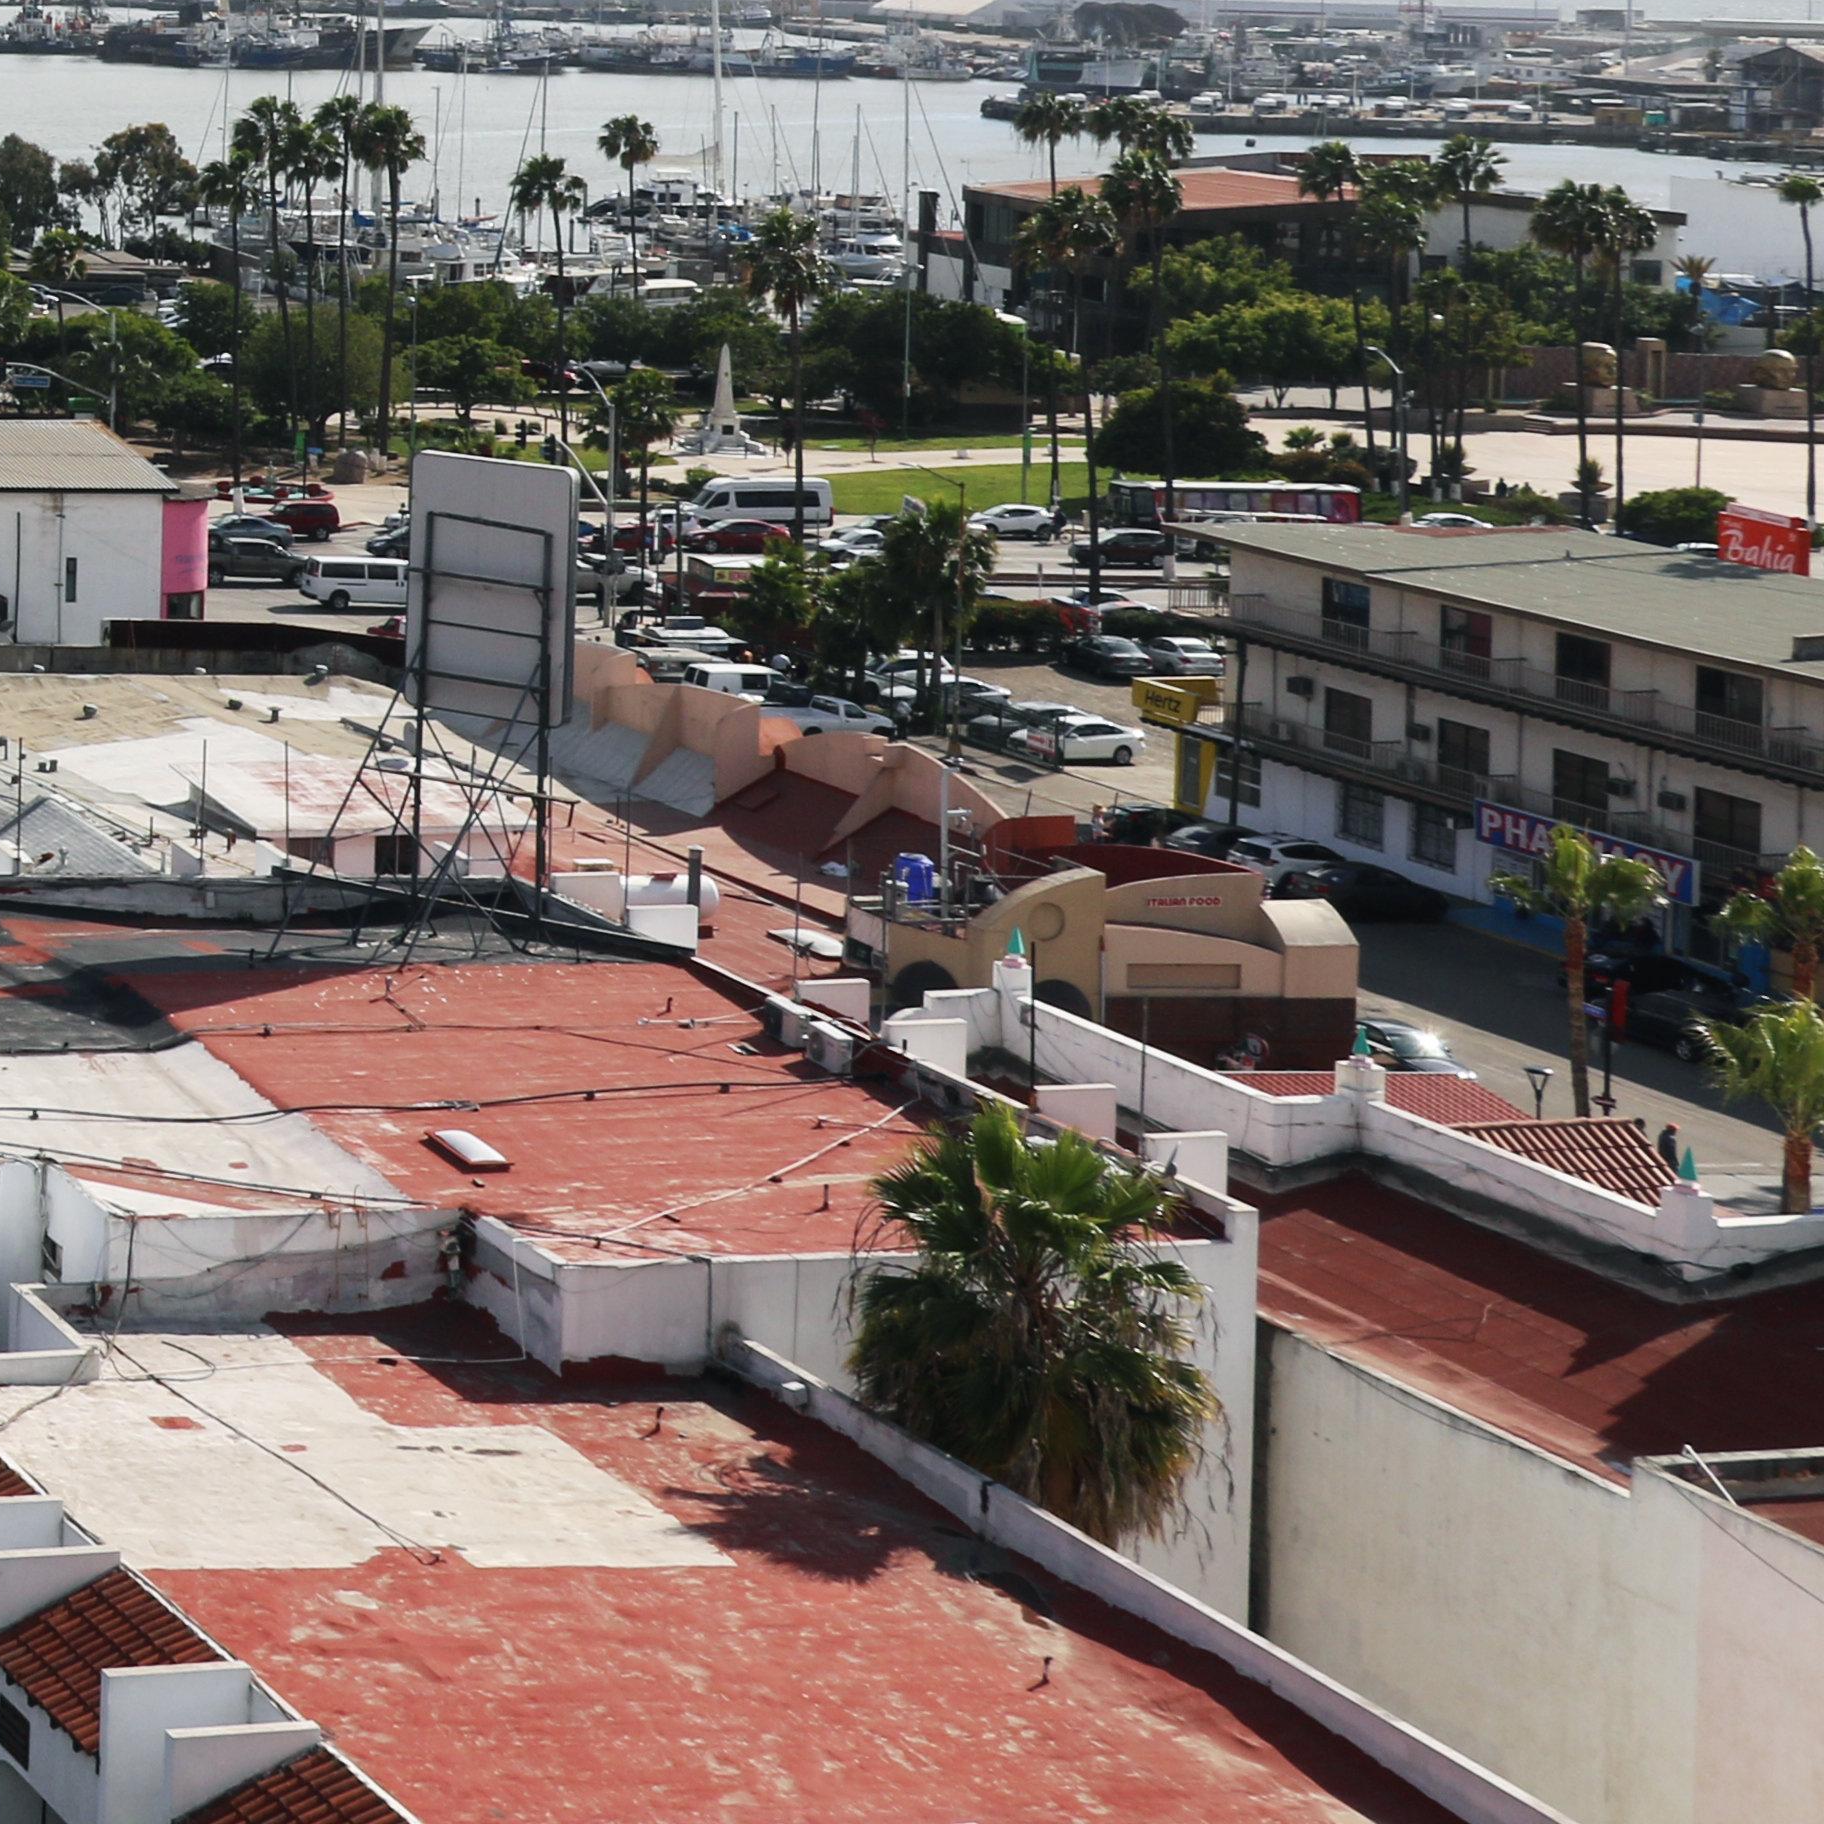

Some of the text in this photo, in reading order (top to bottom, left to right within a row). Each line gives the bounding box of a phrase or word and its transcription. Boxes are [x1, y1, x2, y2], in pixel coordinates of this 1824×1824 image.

[1145, 689, 1182, 714] Hertz
[1145, 896, 1221, 907] ITALIAN FOOD
